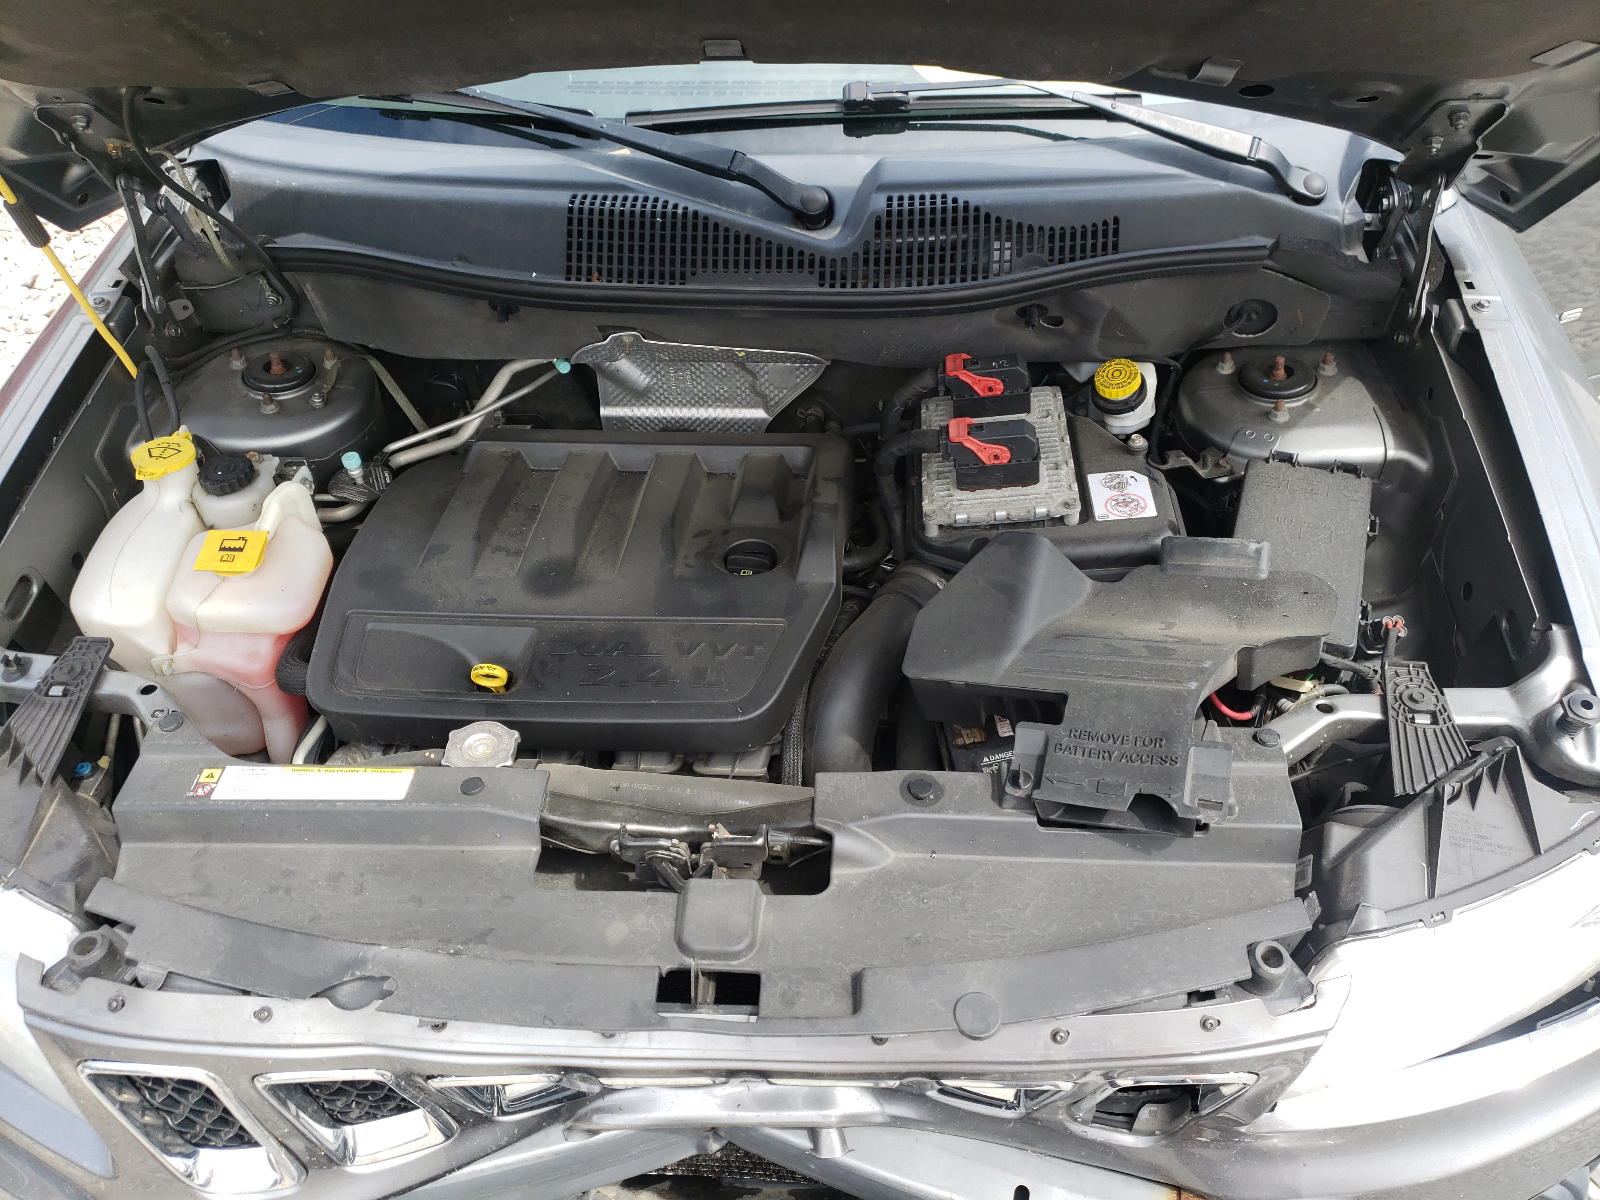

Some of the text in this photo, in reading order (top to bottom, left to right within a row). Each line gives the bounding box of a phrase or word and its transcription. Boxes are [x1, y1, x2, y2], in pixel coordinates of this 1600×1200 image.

[674, 641, 767, 660] VVT
[1068, 728, 1166, 749] REMOVE FOR
[989, 750, 1015, 761] DANGE
[1053, 742, 1179, 767] BATTERY ACCESS
